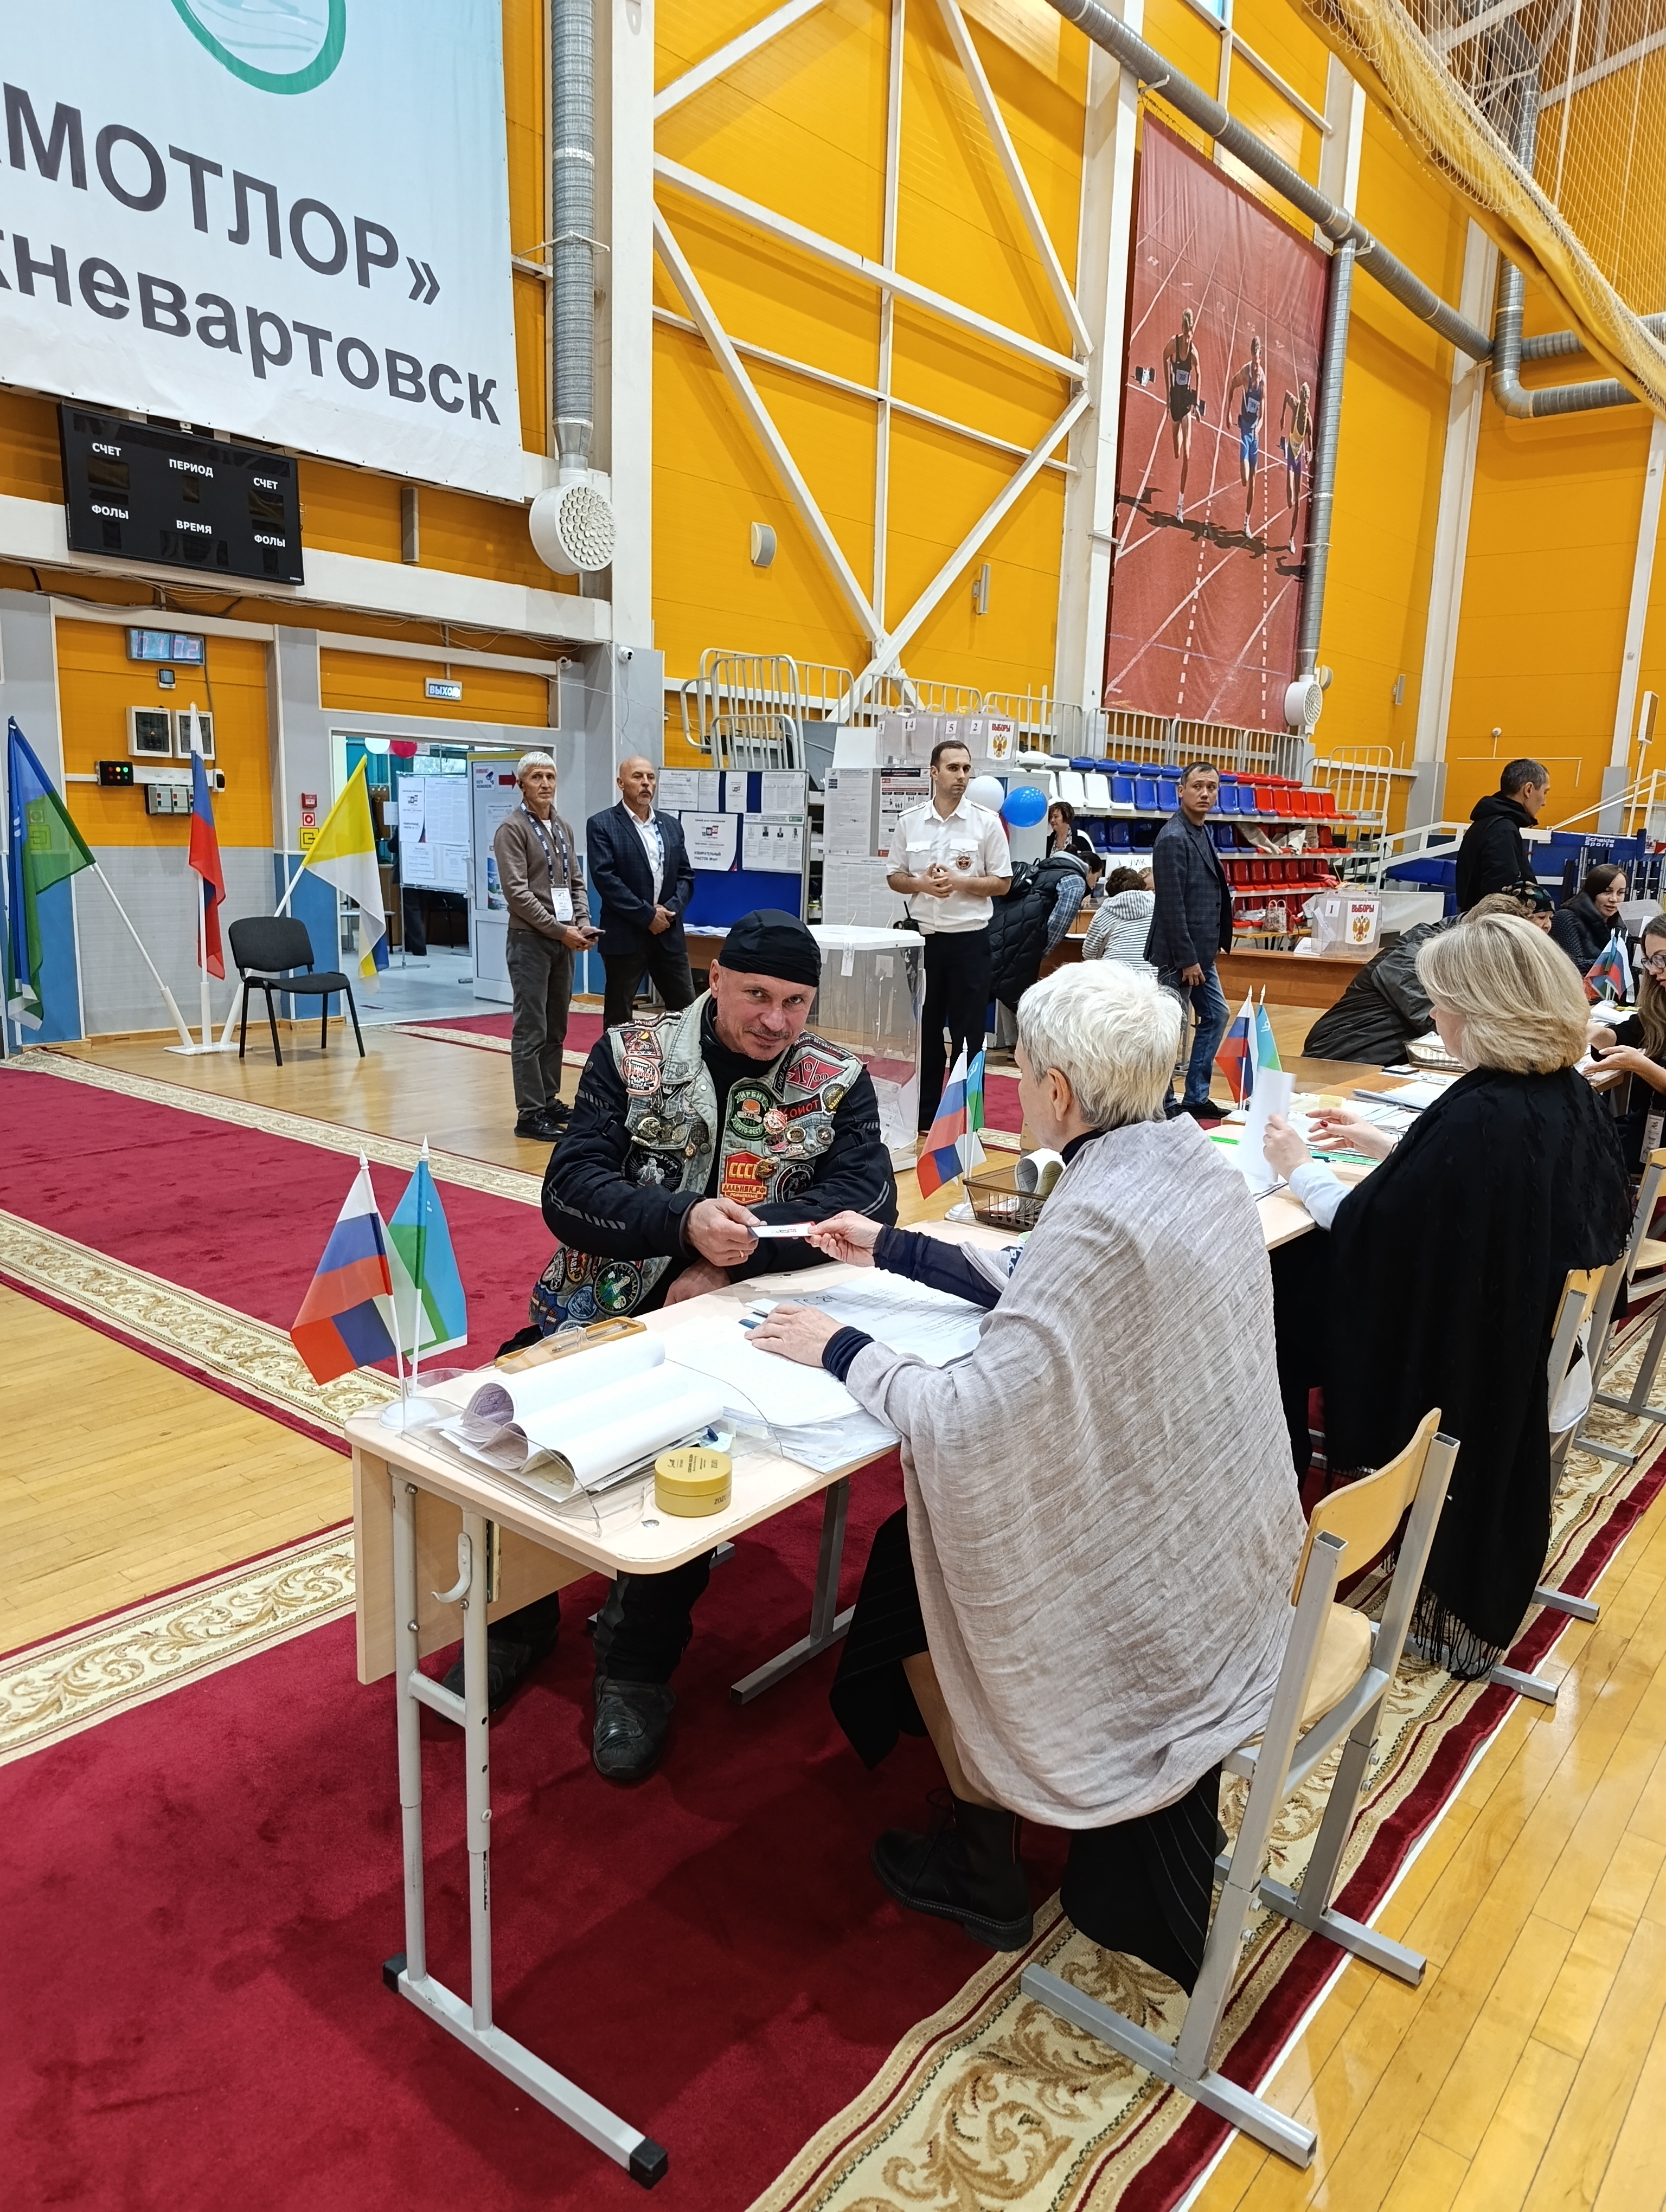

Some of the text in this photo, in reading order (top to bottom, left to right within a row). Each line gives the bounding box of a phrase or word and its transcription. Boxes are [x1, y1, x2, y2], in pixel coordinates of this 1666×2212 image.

[0, 81, 440, 305] МОТЛОР»
[92, 442, 121, 456] СЧЕТ
[169, 458, 214, 478] ПЕРИОД
[253, 477, 278, 490] СЧЕТ
[92, 504, 129, 520] ФОЛЫ
[176, 520, 212, 535] ВРЕМЯ
[254, 535, 286, 548] ФОЛЫ
[878, 723, 883, 732] 3
[909, 721, 914, 729] 4
[949, 723, 954, 732] 5
[972, 723, 978, 731] 2
[991, 723, 1010, 732] ВЫБОРЫ
[1329, 904, 1334, 914] 1
[1351, 904, 1375, 913] ВЫБОРЫ
[740, 1091, 767, 1104] ИРБИТ
[734, 1121, 761, 1135] МОТО-ФЕСТ
[723, 1184, 766, 1193] ДАЛЬНЯК.РФ
